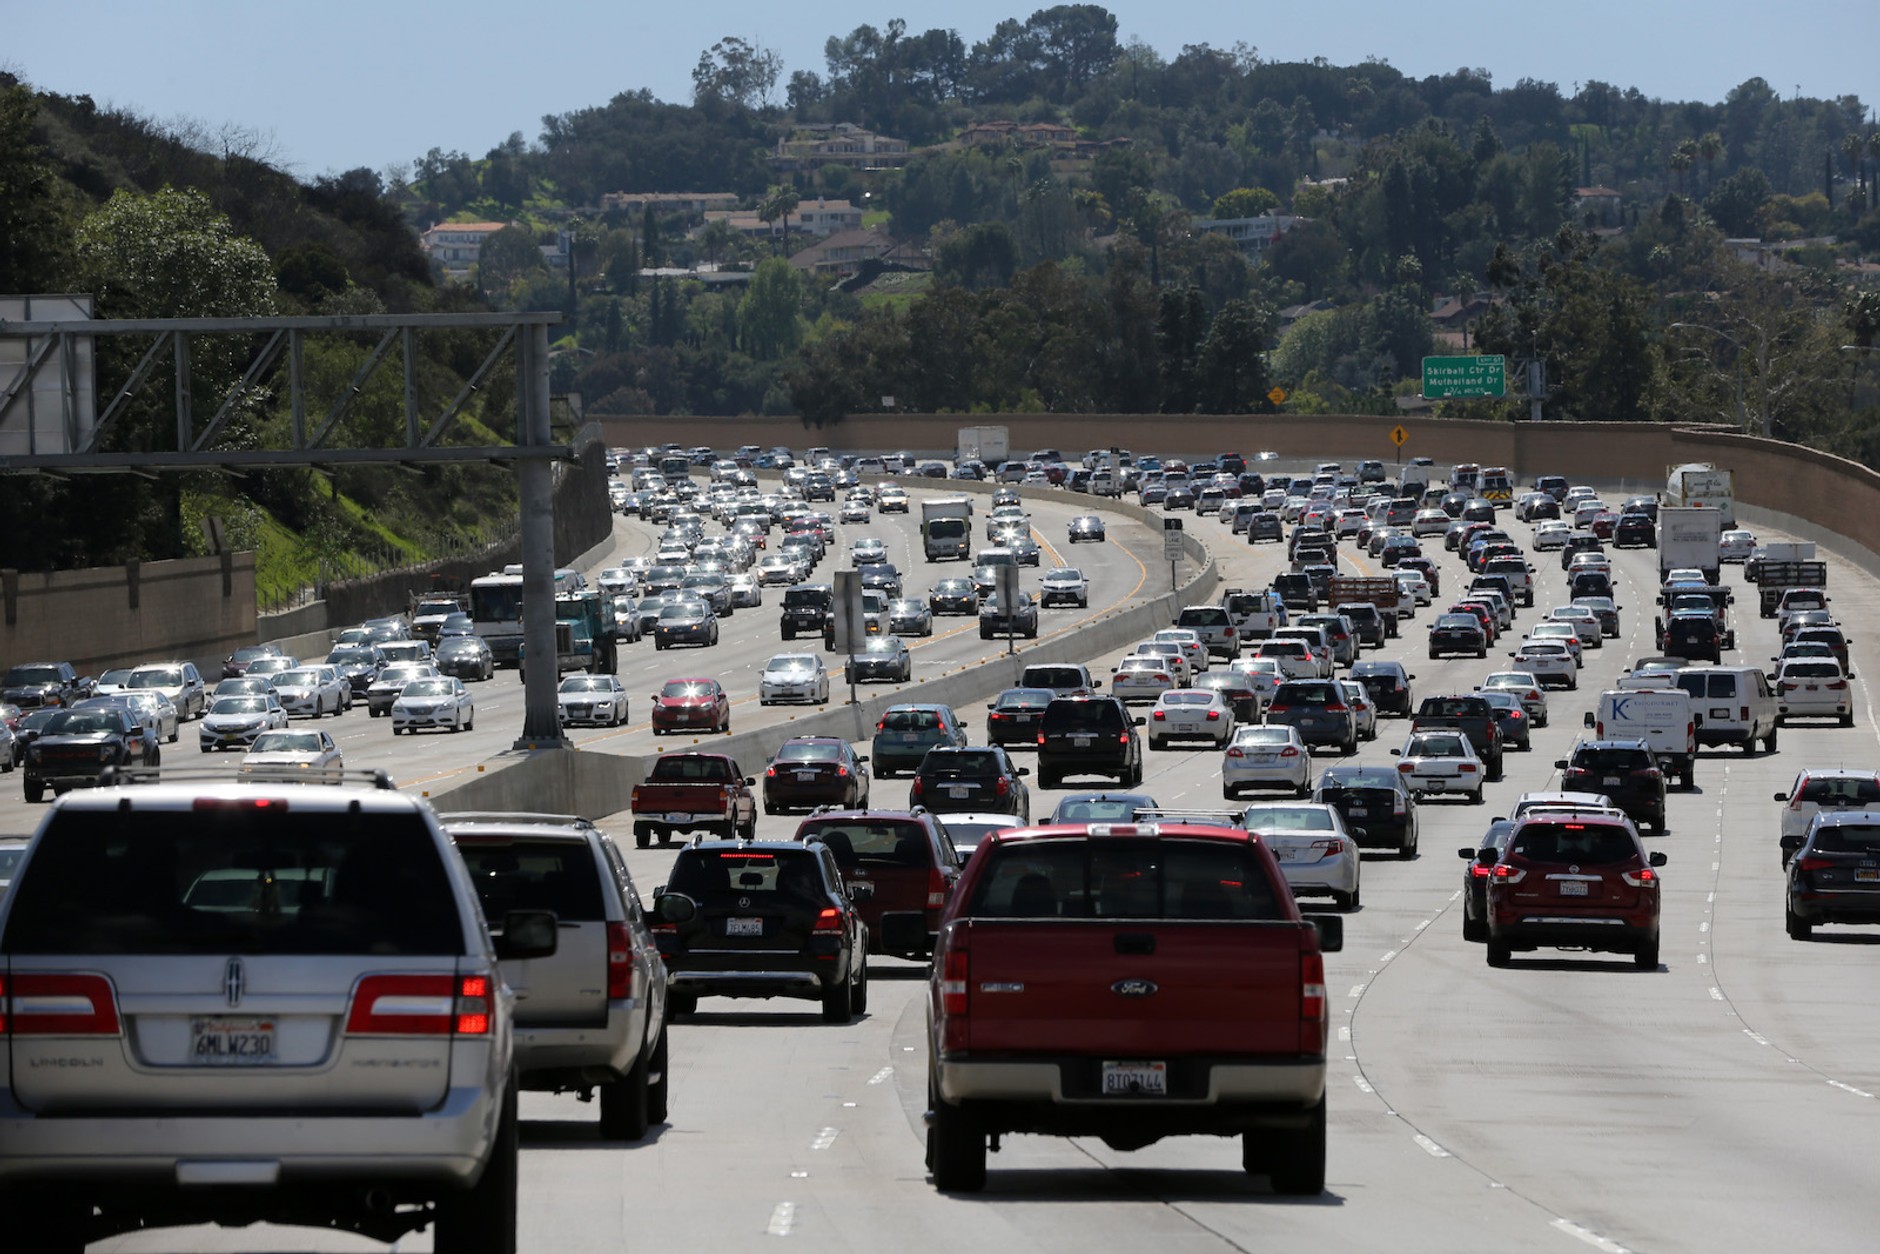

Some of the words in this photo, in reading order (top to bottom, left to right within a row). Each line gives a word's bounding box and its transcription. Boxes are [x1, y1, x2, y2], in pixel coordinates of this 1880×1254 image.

[1427, 367, 1464, 375] Skirball
[1469, 366, 1484, 374] Ctr
[1488, 366, 1501, 374] Dr
[1429, 377, 1482, 386] Mulholland
[1486, 376, 1498, 384] Dr
[1611, 698, 1633, 721] K
[1121, 982, 1148, 994] Ford
[196, 1034, 271, 1056] 6MLW230
[29, 1057, 104, 1068] LINCOLN
